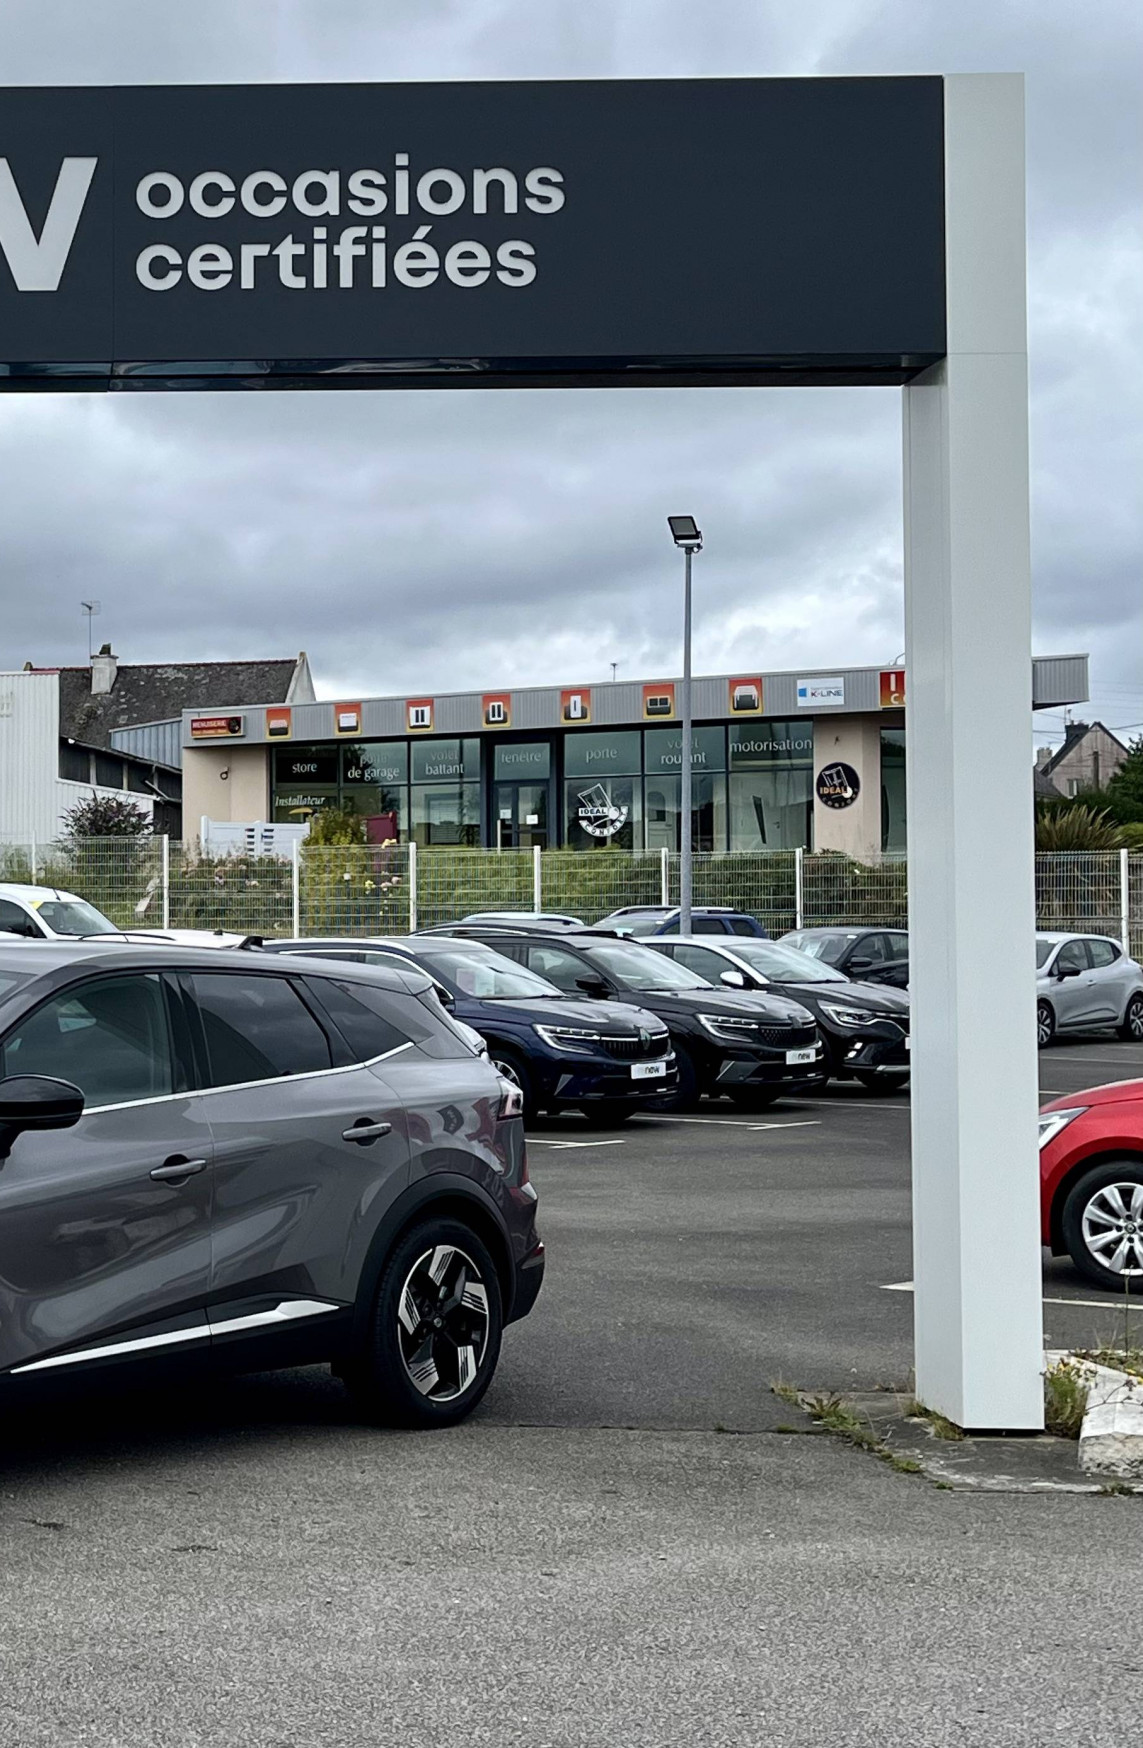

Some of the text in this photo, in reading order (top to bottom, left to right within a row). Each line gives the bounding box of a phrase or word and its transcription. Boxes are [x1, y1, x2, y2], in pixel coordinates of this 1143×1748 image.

[136, 152, 566, 218] occasions
[135, 224, 537, 291] certifiées
[729, 738, 813, 752] motorisation
[586, 748, 617, 763] porte
[292, 762, 317, 773] store
[348, 766, 400, 781] de garage
[425, 763, 464, 775] battant
[819, 786, 847, 794] IDEAL
[275, 795, 326, 807] Installateur
